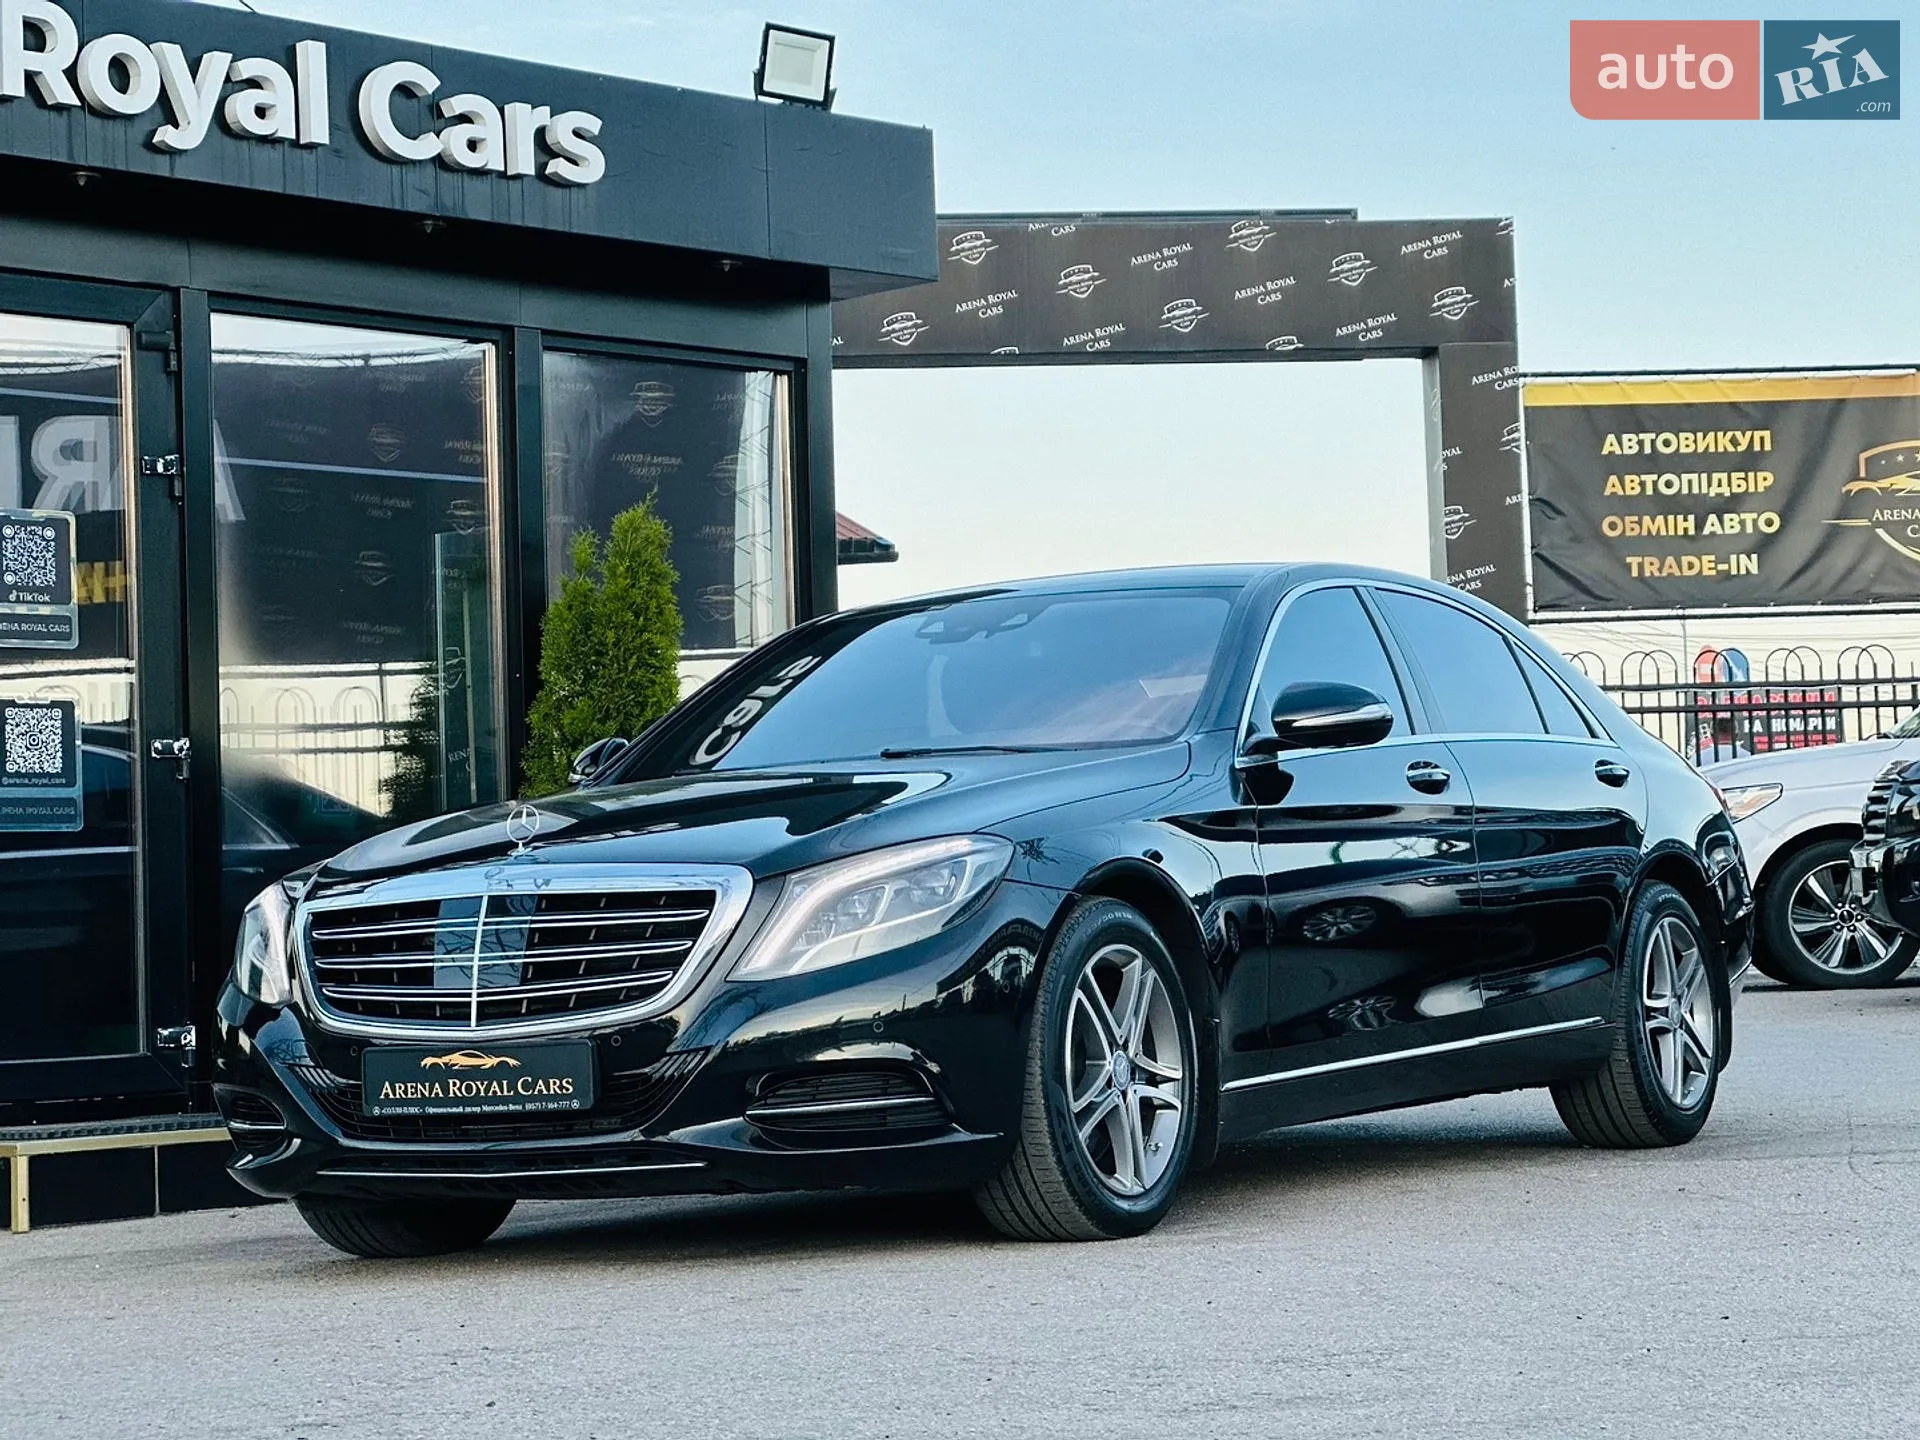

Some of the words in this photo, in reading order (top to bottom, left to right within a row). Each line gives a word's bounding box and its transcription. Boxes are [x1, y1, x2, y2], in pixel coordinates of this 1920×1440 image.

[0, 0, 331, 152] Royal
[358, 59, 606, 186] Cars
[1130, 250, 1161, 267] ARENA
[1163, 242, 1194, 260] ROYAL
[1400, 240, 1431, 256] ARENA
[1432, 230, 1463, 247] ROYAL
[1423, 246, 1449, 260] CARS
[1153, 257, 1179, 272] CARS
[1234, 285, 1265, 301] ARENA
[1266, 276, 1297, 293] ROYAL
[1257, 291, 1283, 306] CARS
[955, 298, 986, 313] ARENA
[988, 289, 1019, 306] ROYAL
[978, 304, 1004, 319] CARS
[1063, 331, 1094, 347] ARENA
[1095, 323, 1126, 340] ROYAL
[1335, 321, 1367, 337] ARENA
[1367, 312, 1398, 329] ROYAL
[1358, 327, 1384, 342] CARS
[1085, 338, 1112, 352] CARS
[1472, 370, 1503, 385] ARENA
[1601, 430, 1773, 455] АВТОВИКУП
[1603, 471, 1775, 498] АВТОПІДБІР
[1602, 514, 1696, 538] ОБМІН
[1702, 511, 1781, 536] АВТО
[1872, 508, 1920, 522] ARENA
[1466, 564, 1497, 578] ROYAL
[1626, 553, 1760, 578] TRADE-IN
[18, 592, 51, 603] TikTok
[379, 1080, 445, 1100] ARENA
[447, 1077, 513, 1098] ROYAL
[517, 1075, 574, 1096] CARS
